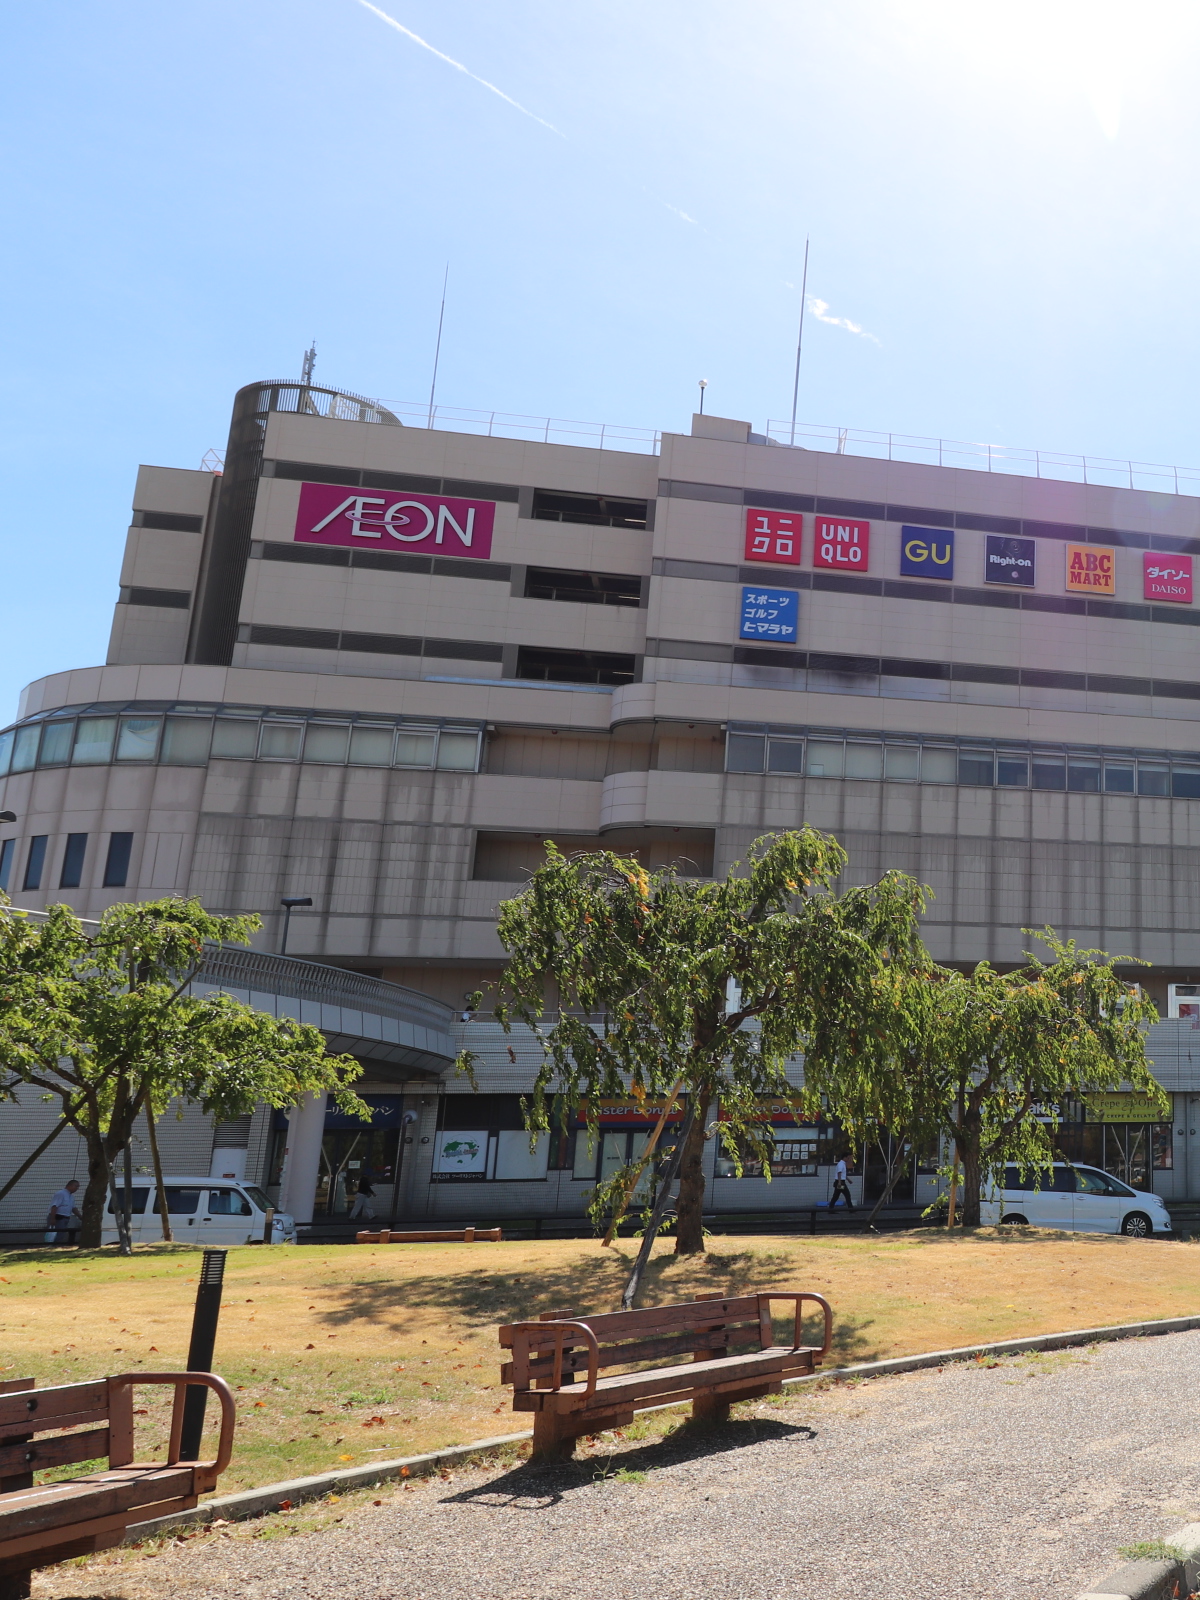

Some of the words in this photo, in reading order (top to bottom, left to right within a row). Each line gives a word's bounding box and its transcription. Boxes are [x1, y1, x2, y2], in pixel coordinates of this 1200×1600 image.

[754, 516, 794, 536] ユニ
[821, 523, 859, 543] UNI
[751, 536, 793, 556] クロ
[820, 543, 862, 563] QLO
[905, 540, 951, 565] GU
[989, 554, 1033, 567] Right-on
[1070, 551, 1112, 573] ABC
[1070, 571, 1112, 587] MART
[1147, 566, 1191, 581] ダイソー
[1151, 584, 1187, 596] DAISO
[745, 593, 790, 607] スポーツ
[744, 608, 779, 619] ゴルフ
[743, 621, 794, 635] ヒマラヤ
